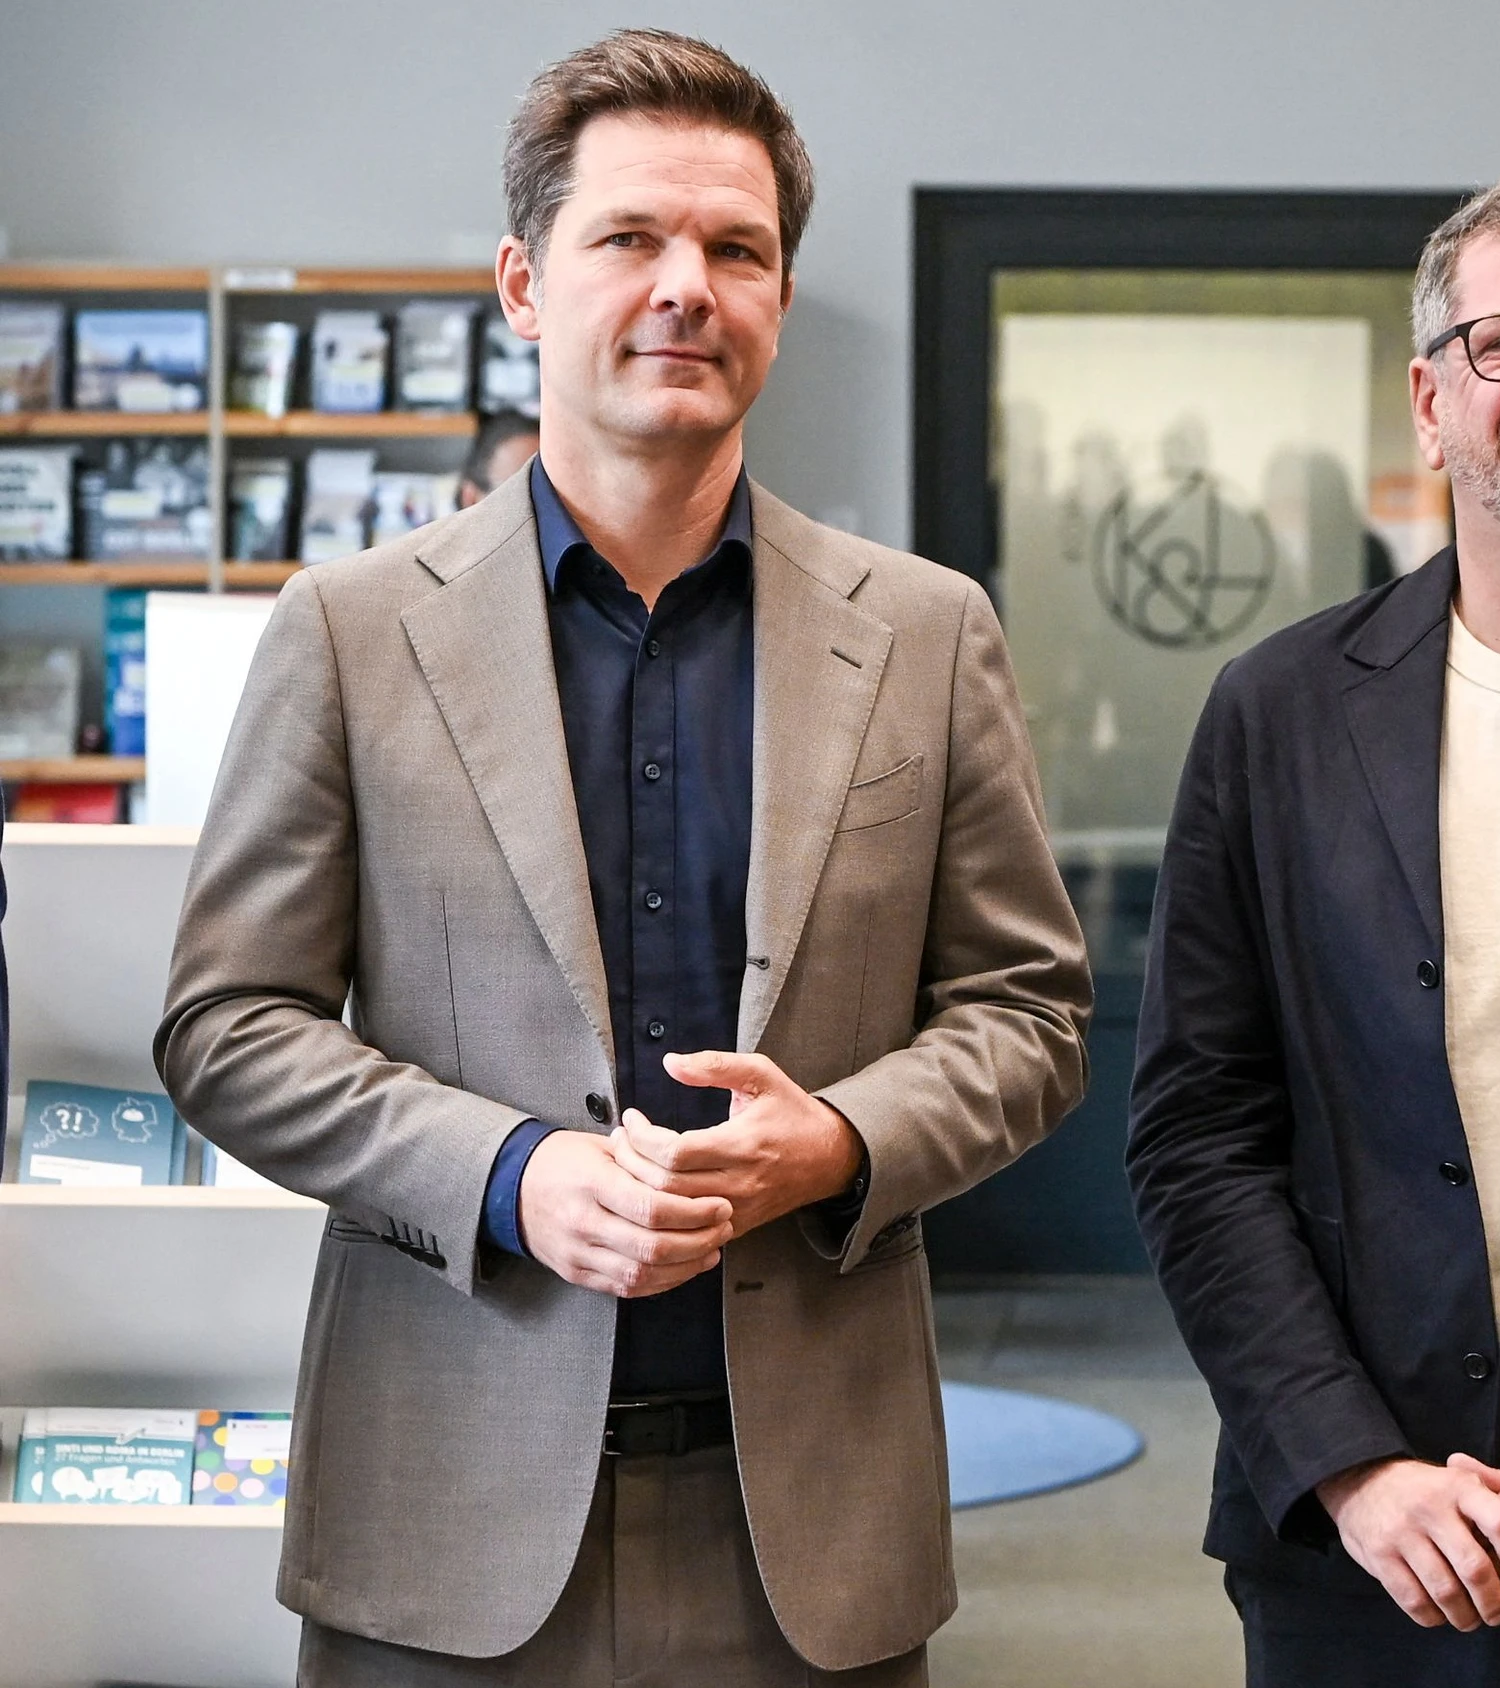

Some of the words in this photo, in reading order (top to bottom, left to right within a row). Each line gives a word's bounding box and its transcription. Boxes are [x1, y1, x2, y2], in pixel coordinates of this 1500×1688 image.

[56, 1109, 82, 1132] ?!
[82, 1444, 104, 1454] UND
[105, 1445, 136, 1455] ROMA
[137, 1446, 149, 1456] IN
[150, 1447, 185, 1458] BERLIN
[69, 1453, 102, 1464] Fragen
[104, 1454, 124, 1464] und
